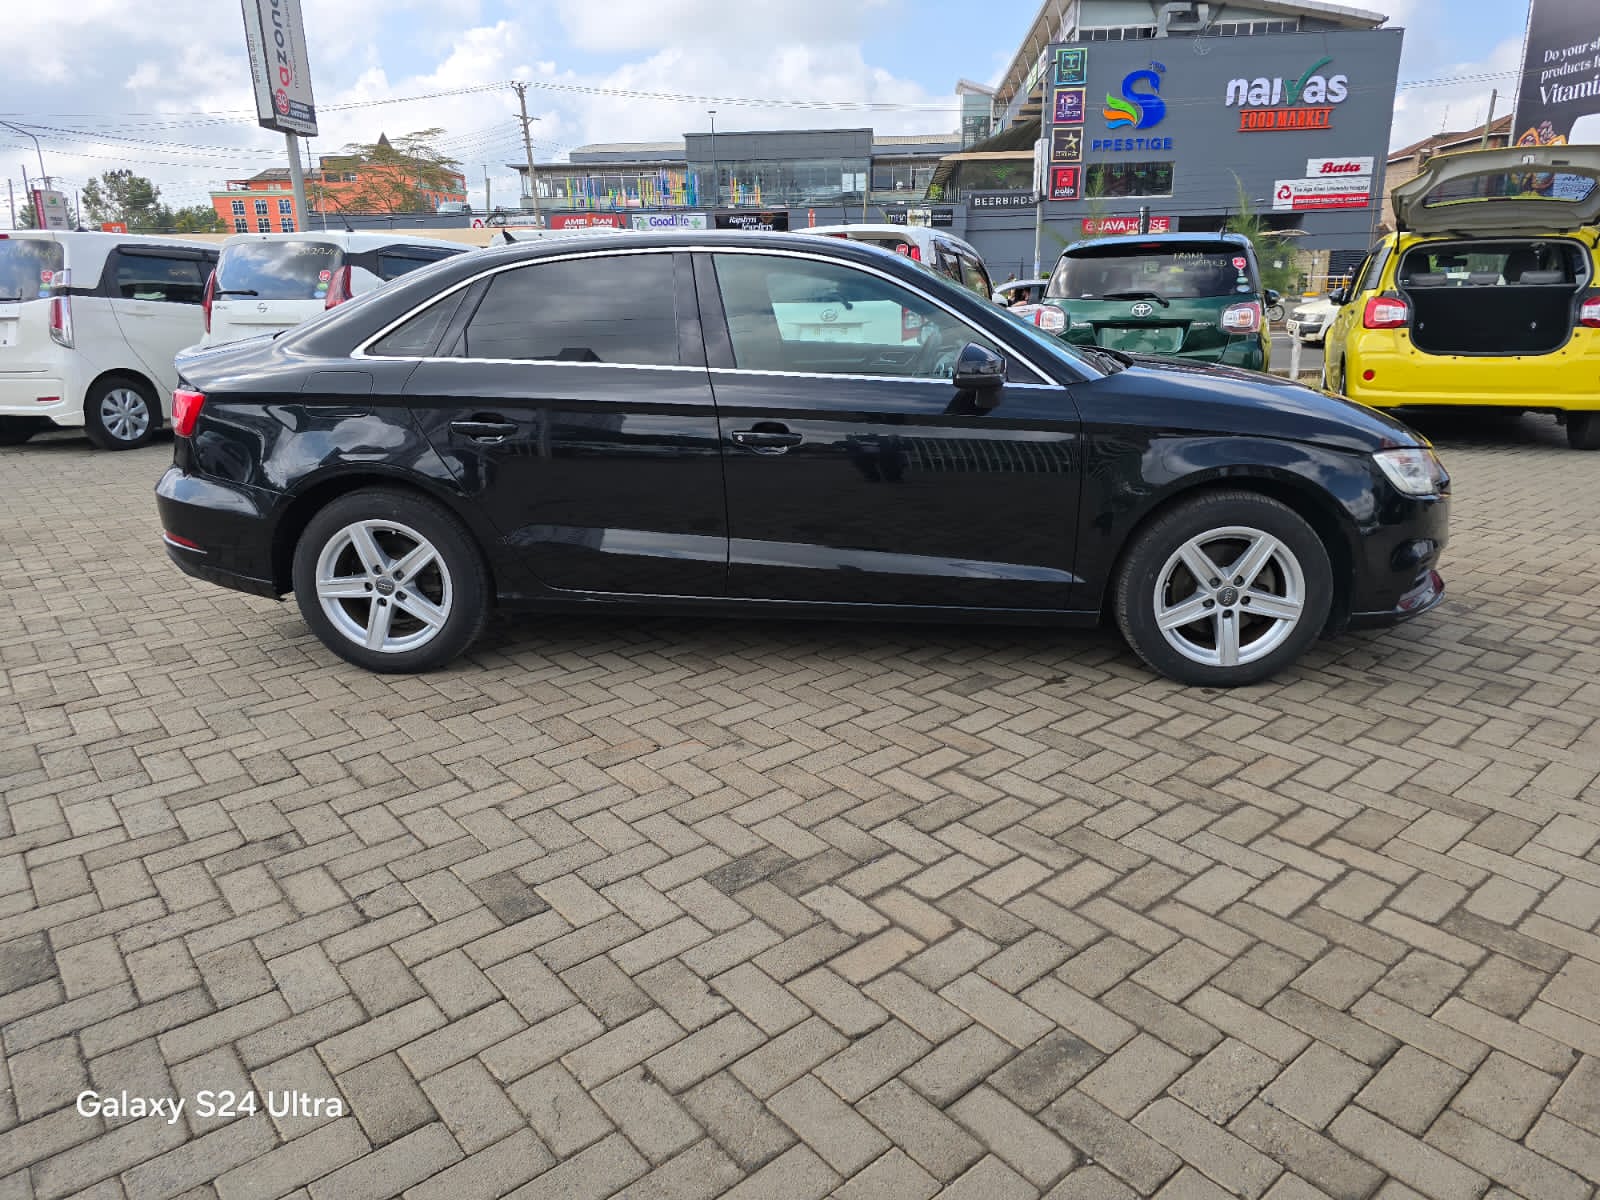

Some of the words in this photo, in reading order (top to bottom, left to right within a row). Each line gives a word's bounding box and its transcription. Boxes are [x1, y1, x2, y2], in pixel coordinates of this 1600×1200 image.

[1544, 49, 1559, 63] Do
[1561, 43, 1588, 61] your
[1541, 60, 1591, 83] products
[1225, 57, 1348, 106] naivas
[1241, 111, 1275, 128] FOOD
[1277, 109, 1330, 127] MARKET
[1092, 137, 1173, 152] PRESTIGE
[1320, 161, 1361, 174] Bata
[974, 196, 1034, 206] BEERBIRDS
[564, 217, 613, 226] AMECAN
[649, 214, 689, 226] Goodlfe
[1098, 219, 1126, 231] JAVA
[1126, 219, 1167, 231] HSE
